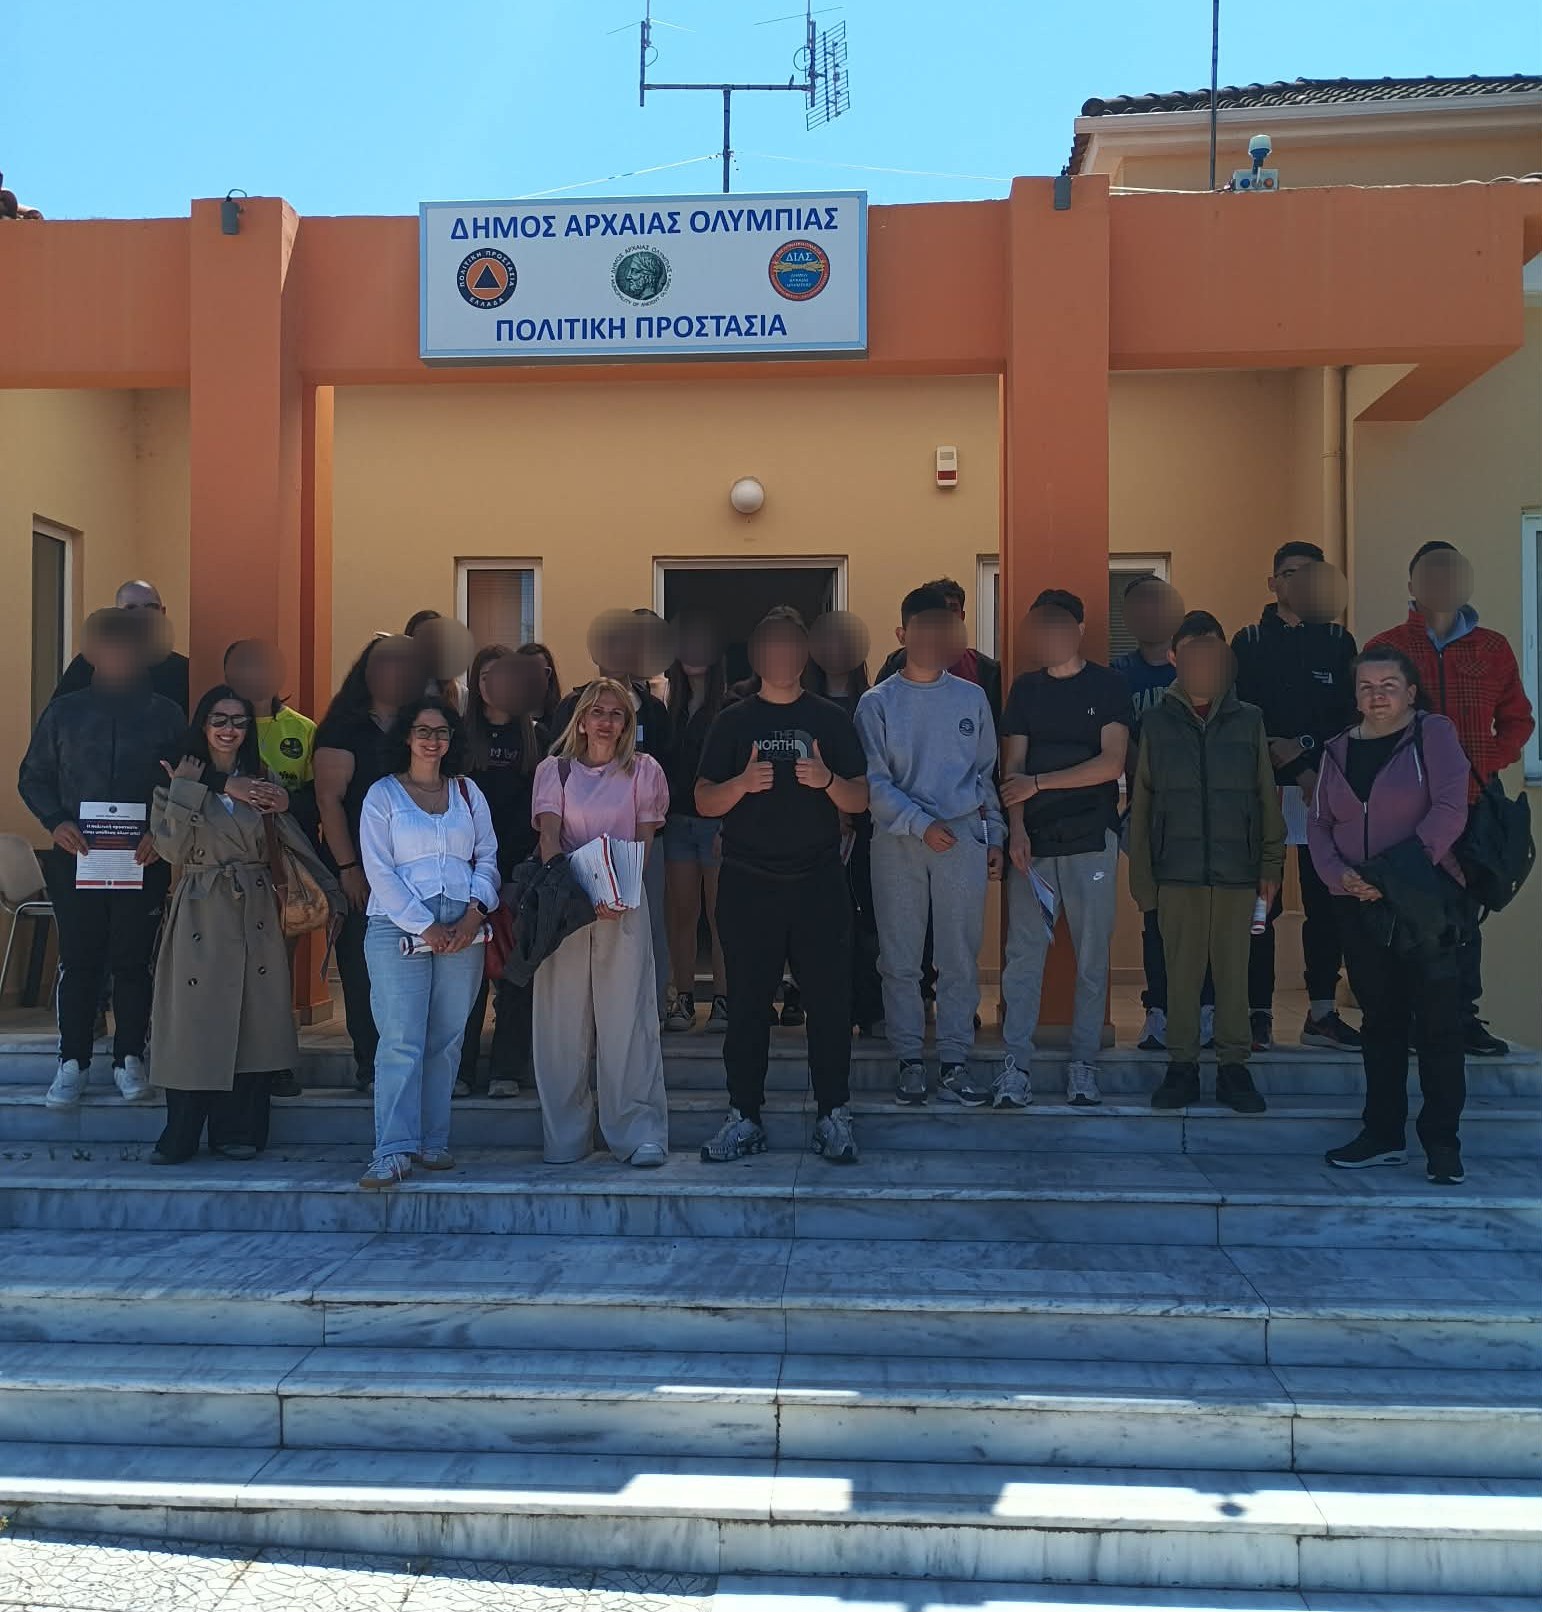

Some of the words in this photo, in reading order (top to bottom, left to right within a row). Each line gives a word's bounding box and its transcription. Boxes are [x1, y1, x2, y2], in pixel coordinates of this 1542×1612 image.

[451, 215, 557, 240] ΔΗΜΟΣ
[565, 211, 681, 237] ΑΡΧΑΙΑΣ
[690, 207, 839, 233] ΟΛΥΜΠΙΑΣ
[786, 252, 813, 262] ΔΙΑΣ
[496, 317, 626, 342] ΠΟΛΙΤΙΚΗ
[636, 313, 788, 339] ΠΡΟΣΤΑΣΙΑ
